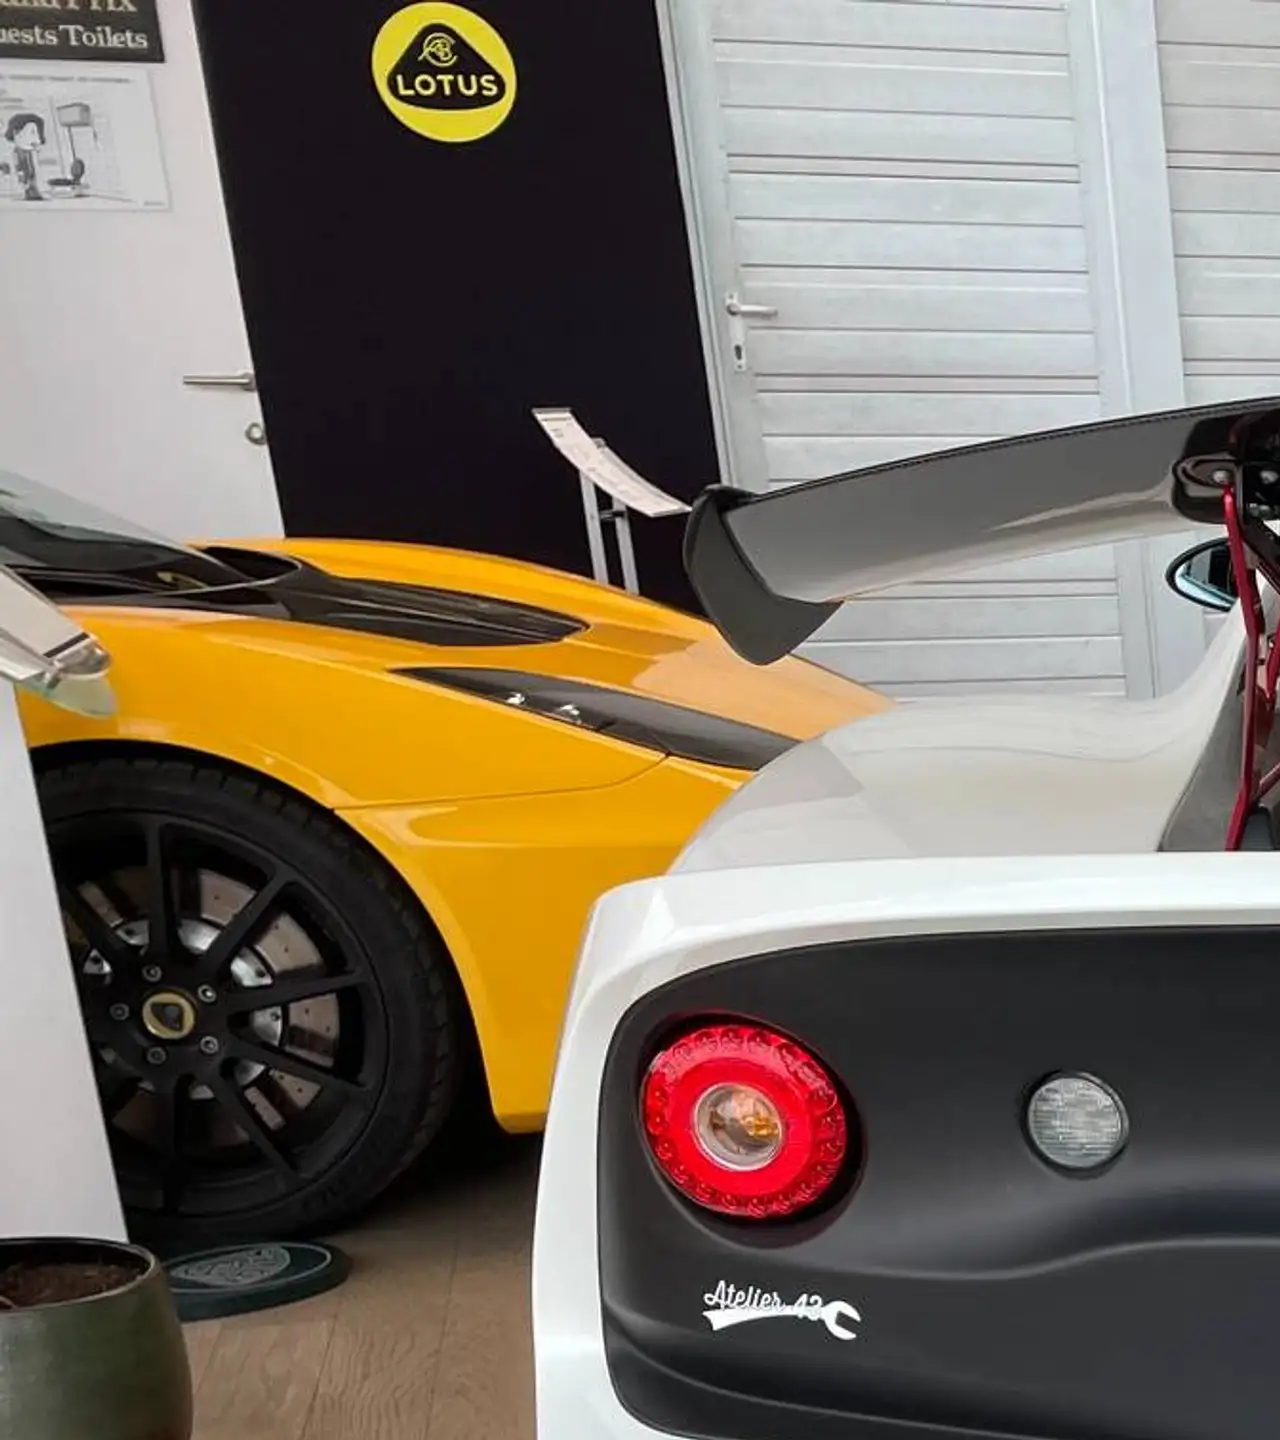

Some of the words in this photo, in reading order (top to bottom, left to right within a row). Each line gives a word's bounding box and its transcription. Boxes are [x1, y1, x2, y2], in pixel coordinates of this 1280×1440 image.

[59, 24, 148, 48] Toilets
[396, 73, 498, 96] LOTUS
[703, 1279, 786, 1312] Atelier
